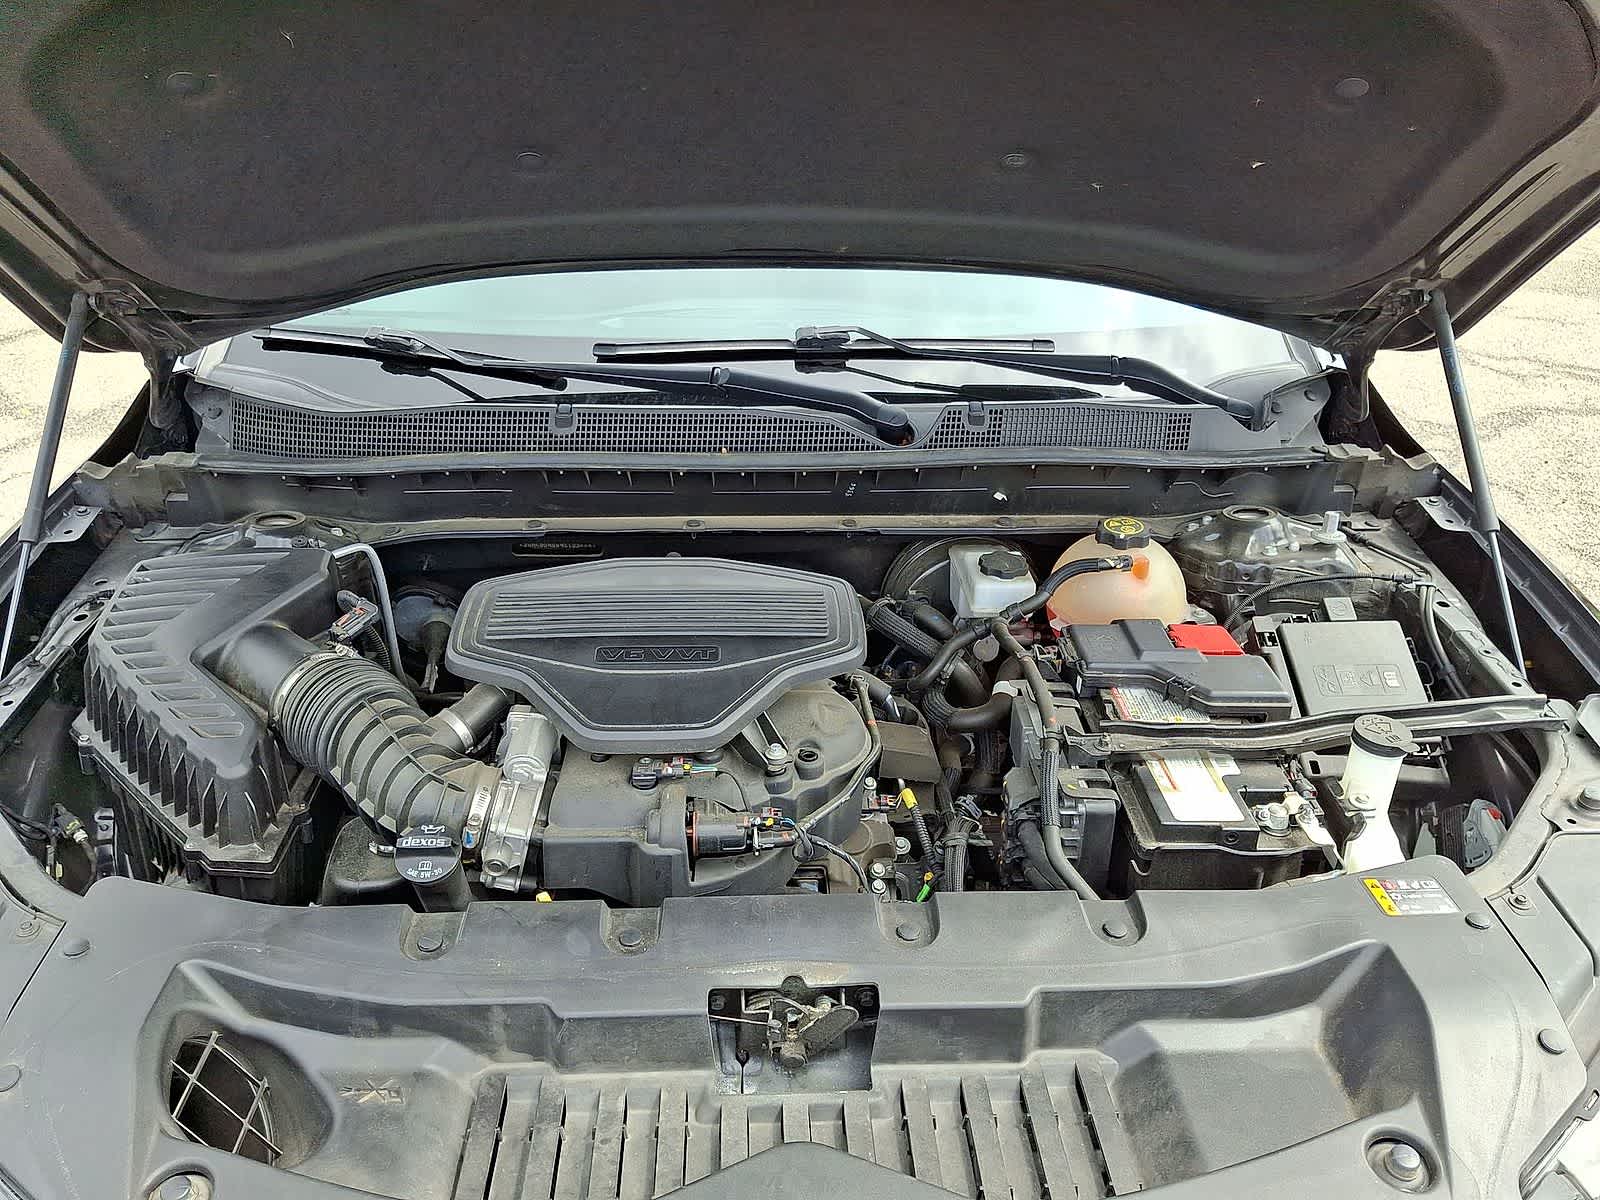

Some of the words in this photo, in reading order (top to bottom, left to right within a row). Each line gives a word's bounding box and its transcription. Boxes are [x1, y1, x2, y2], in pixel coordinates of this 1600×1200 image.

[600, 648, 645, 660] V6
[650, 648, 716, 660] VVT
[402, 837, 445, 847] dexos
[420, 868, 443, 878] 5W-30
